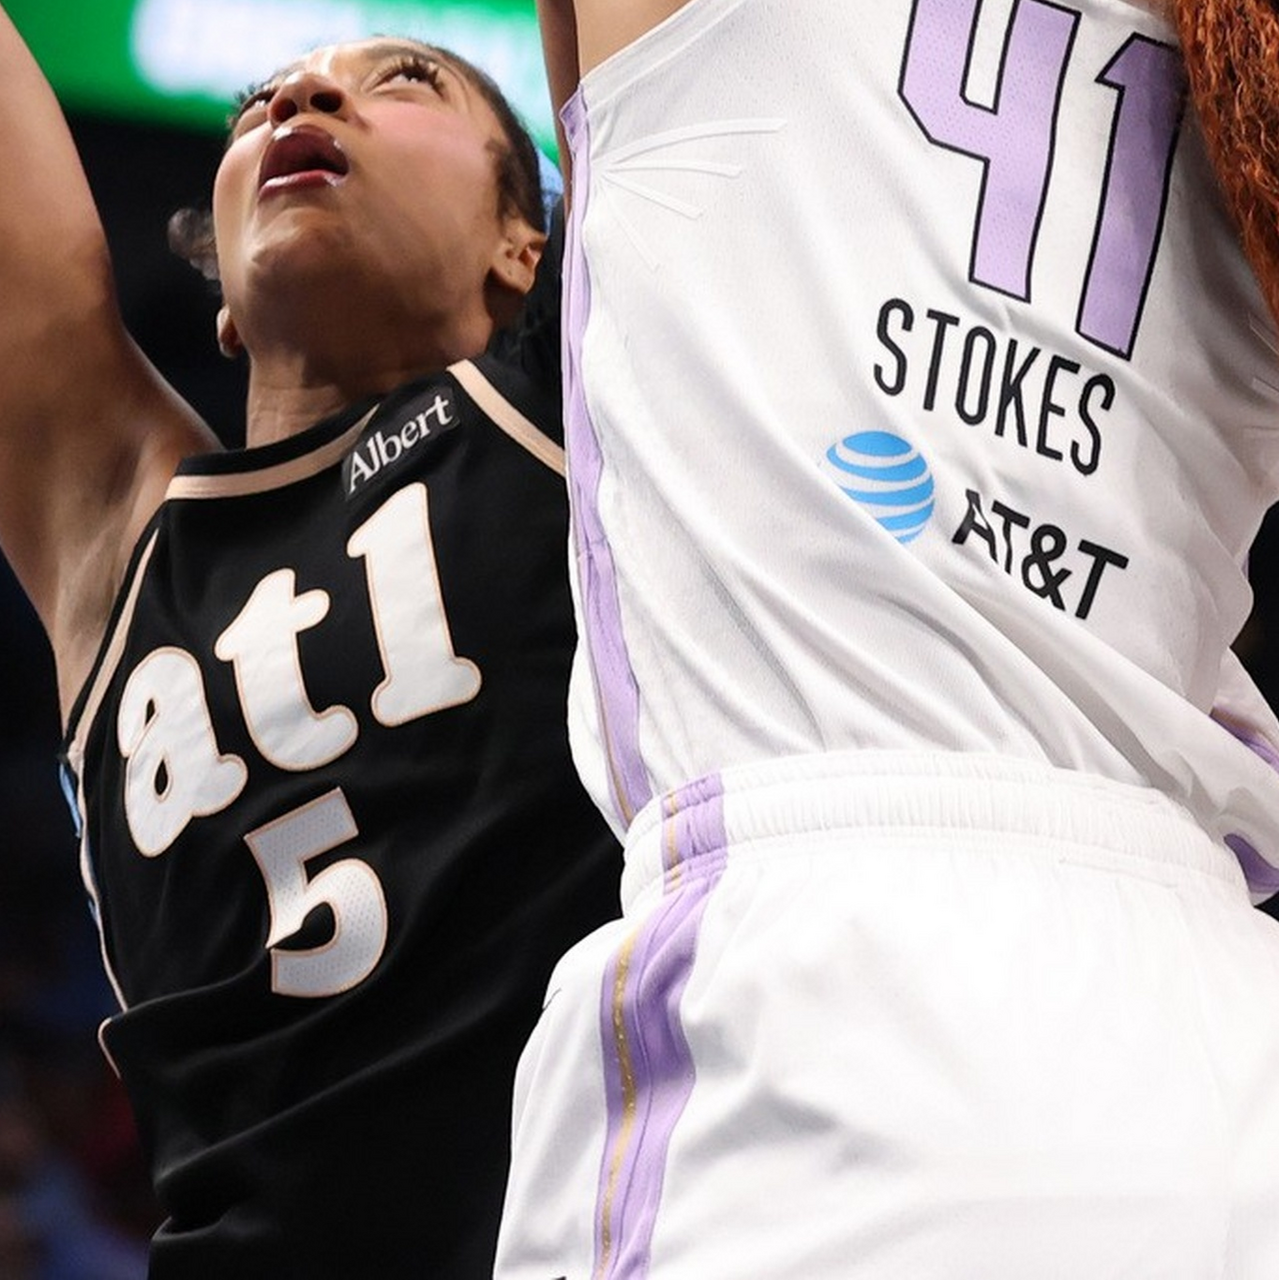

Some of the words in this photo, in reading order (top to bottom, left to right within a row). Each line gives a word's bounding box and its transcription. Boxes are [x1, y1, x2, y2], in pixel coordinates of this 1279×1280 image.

[345, 390, 453, 497] Albert
[873, 297, 1116, 477] STOKES
[951, 488, 1129, 622] AT&T
[243, 786, 389, 999] 5
